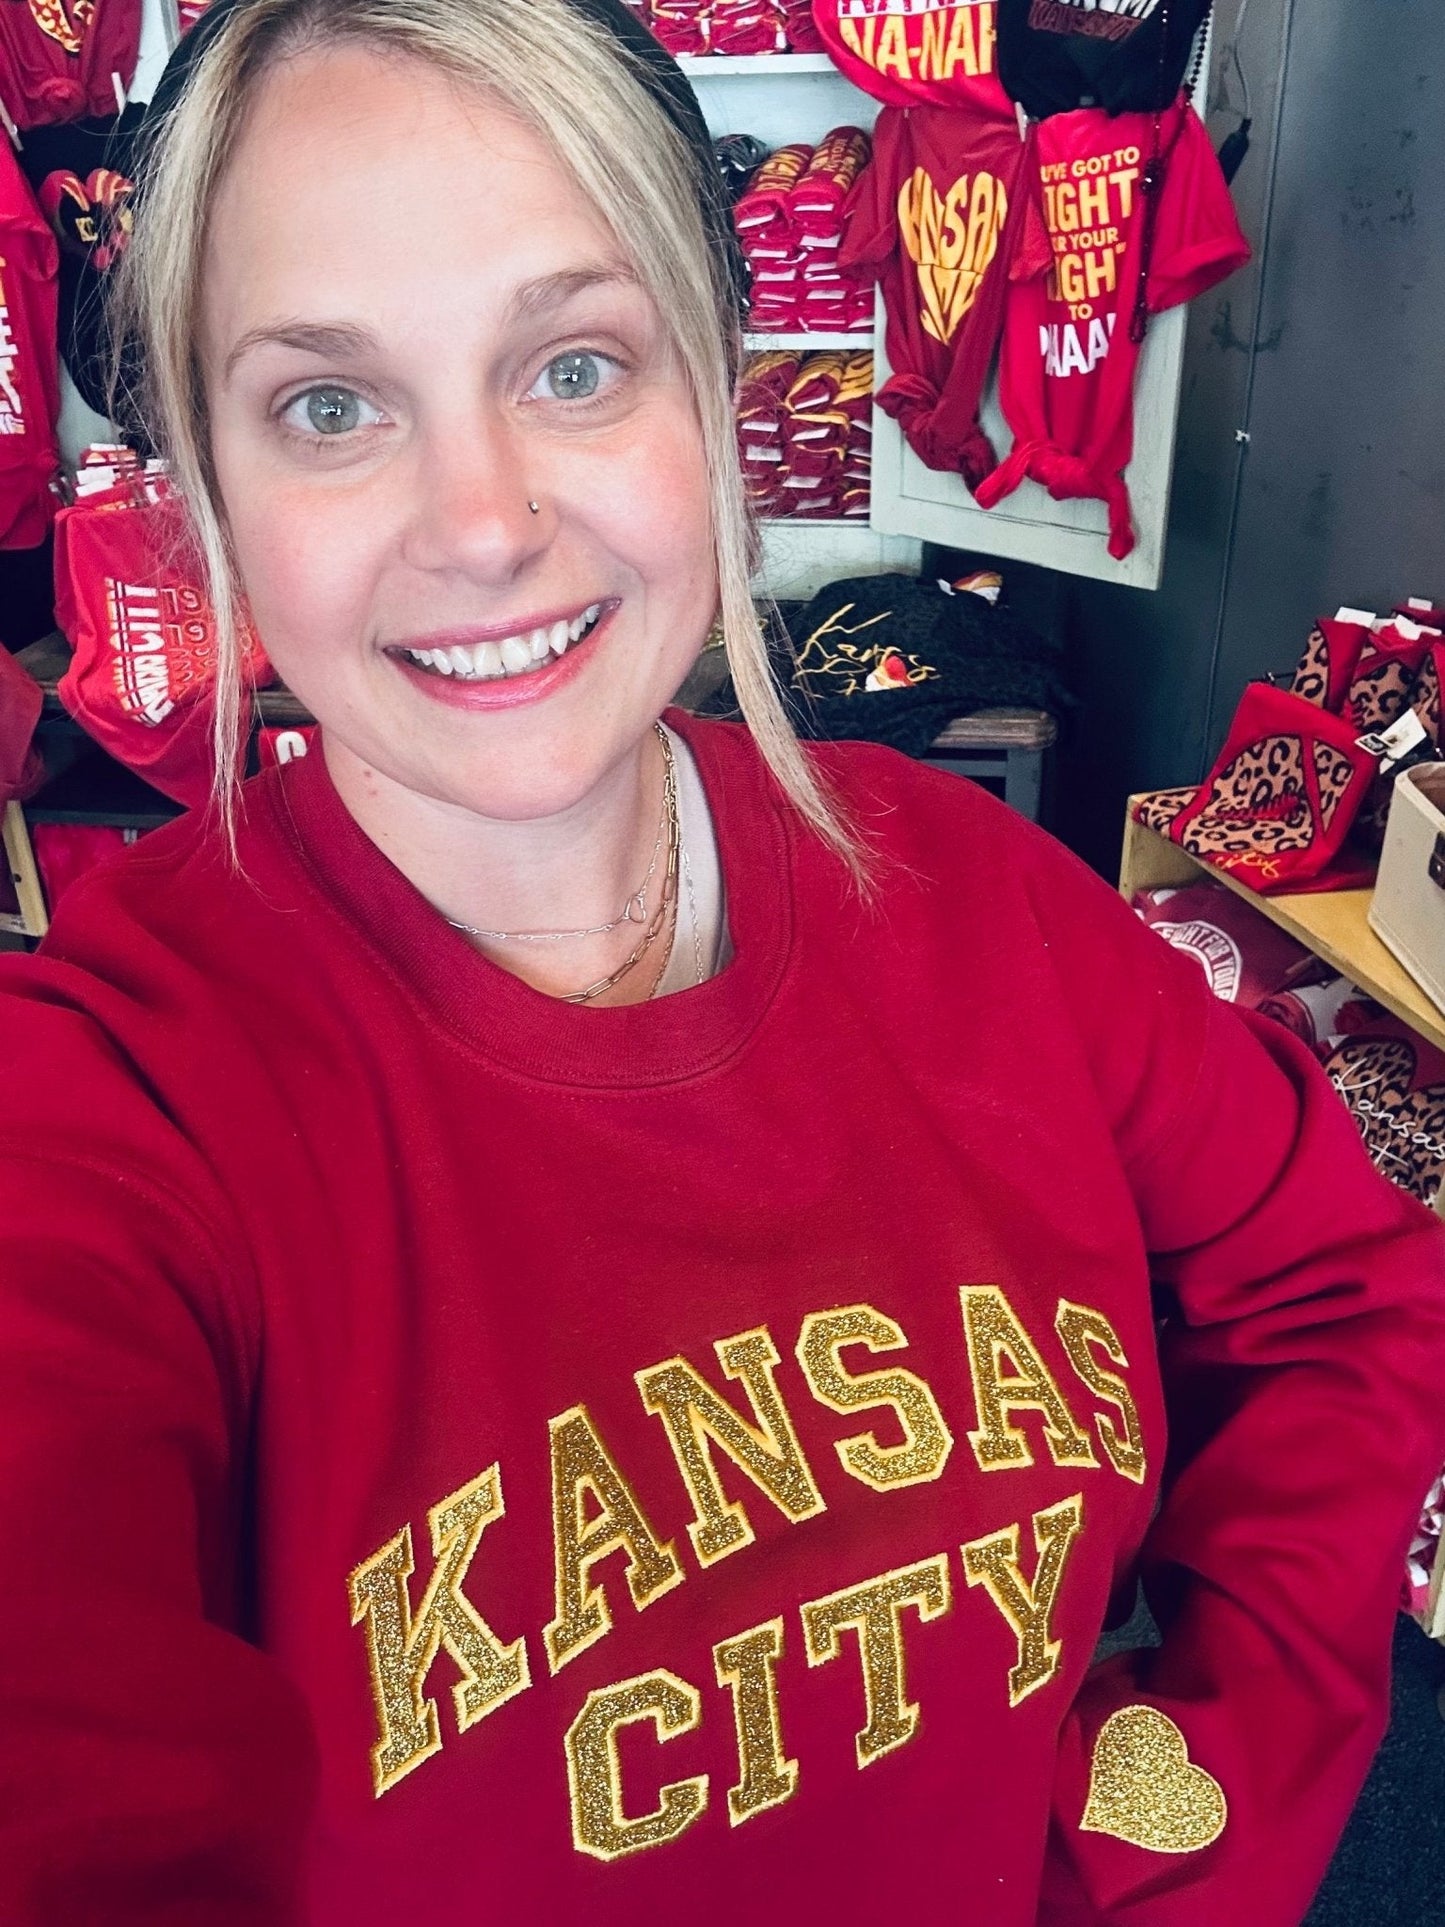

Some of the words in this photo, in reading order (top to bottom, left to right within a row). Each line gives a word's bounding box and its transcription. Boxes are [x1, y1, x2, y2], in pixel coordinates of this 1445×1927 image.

[1071, 154, 1112, 177] GOT
[1113, 146, 1140, 168] TO
[1043, 167, 1139, 233] IGHT
[1069, 226, 1119, 250] YOUR
[1068, 303, 1093, 321] TO
[346, 1284, 1147, 1800] KANSAS
[564, 1493, 1084, 1862] CITY
